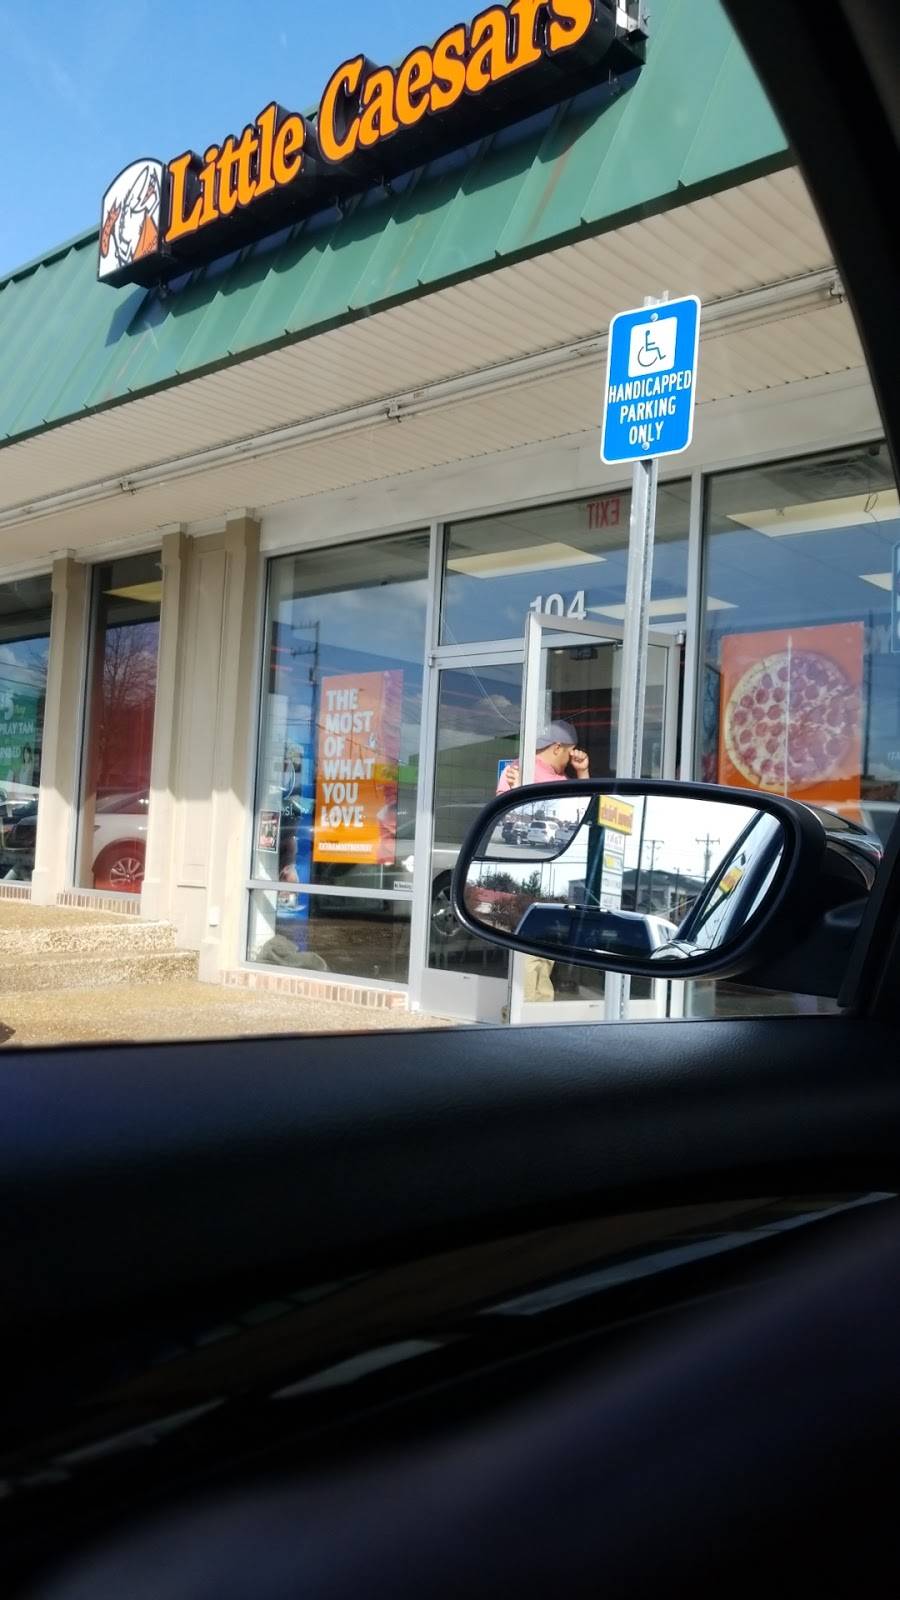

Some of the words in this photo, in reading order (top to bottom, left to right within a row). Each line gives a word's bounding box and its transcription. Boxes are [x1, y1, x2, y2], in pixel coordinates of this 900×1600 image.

[165, 102, 305, 244] Little
[608, 369, 693, 404] HANDICAPPED
[619, 396, 677, 424] PARKING
[628, 420, 665, 445] ONLY
[529, 590, 587, 621] 104
[326, 687, 360, 712] THE
[324, 710, 374, 735] MOST
[323, 735, 346, 759] OF
[322, 757, 376, 782] WHAT
[321, 782, 359, 805] YOU
[319, 804, 365, 829] LOVE
